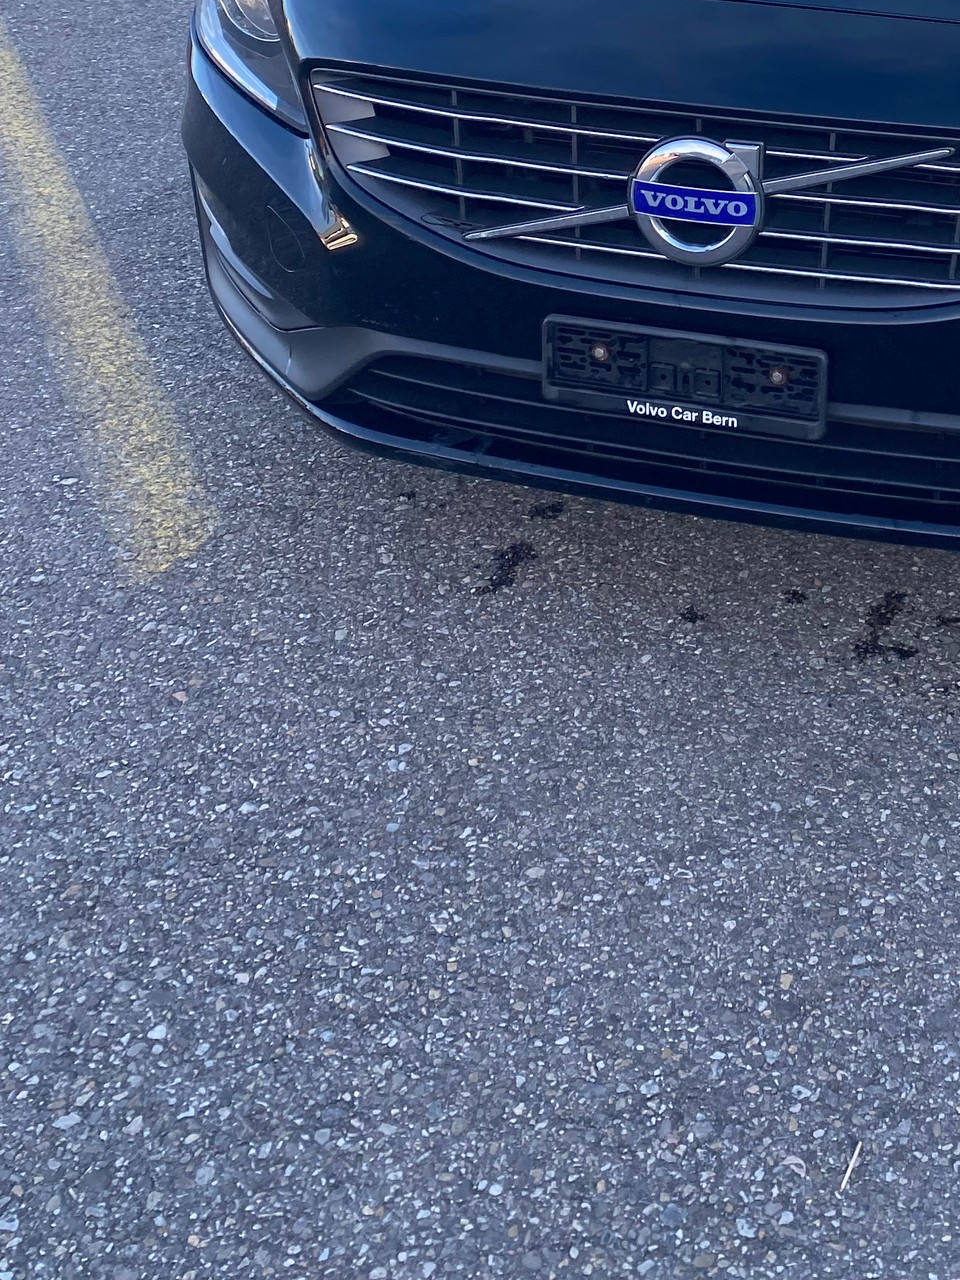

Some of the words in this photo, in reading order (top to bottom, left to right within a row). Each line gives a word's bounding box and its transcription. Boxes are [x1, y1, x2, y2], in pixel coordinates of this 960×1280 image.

[640, 189, 748, 217] VOLVO
[626, 399, 668, 418] Volvo
[671, 406, 699, 422] Car
[702, 410, 738, 428] Bern
